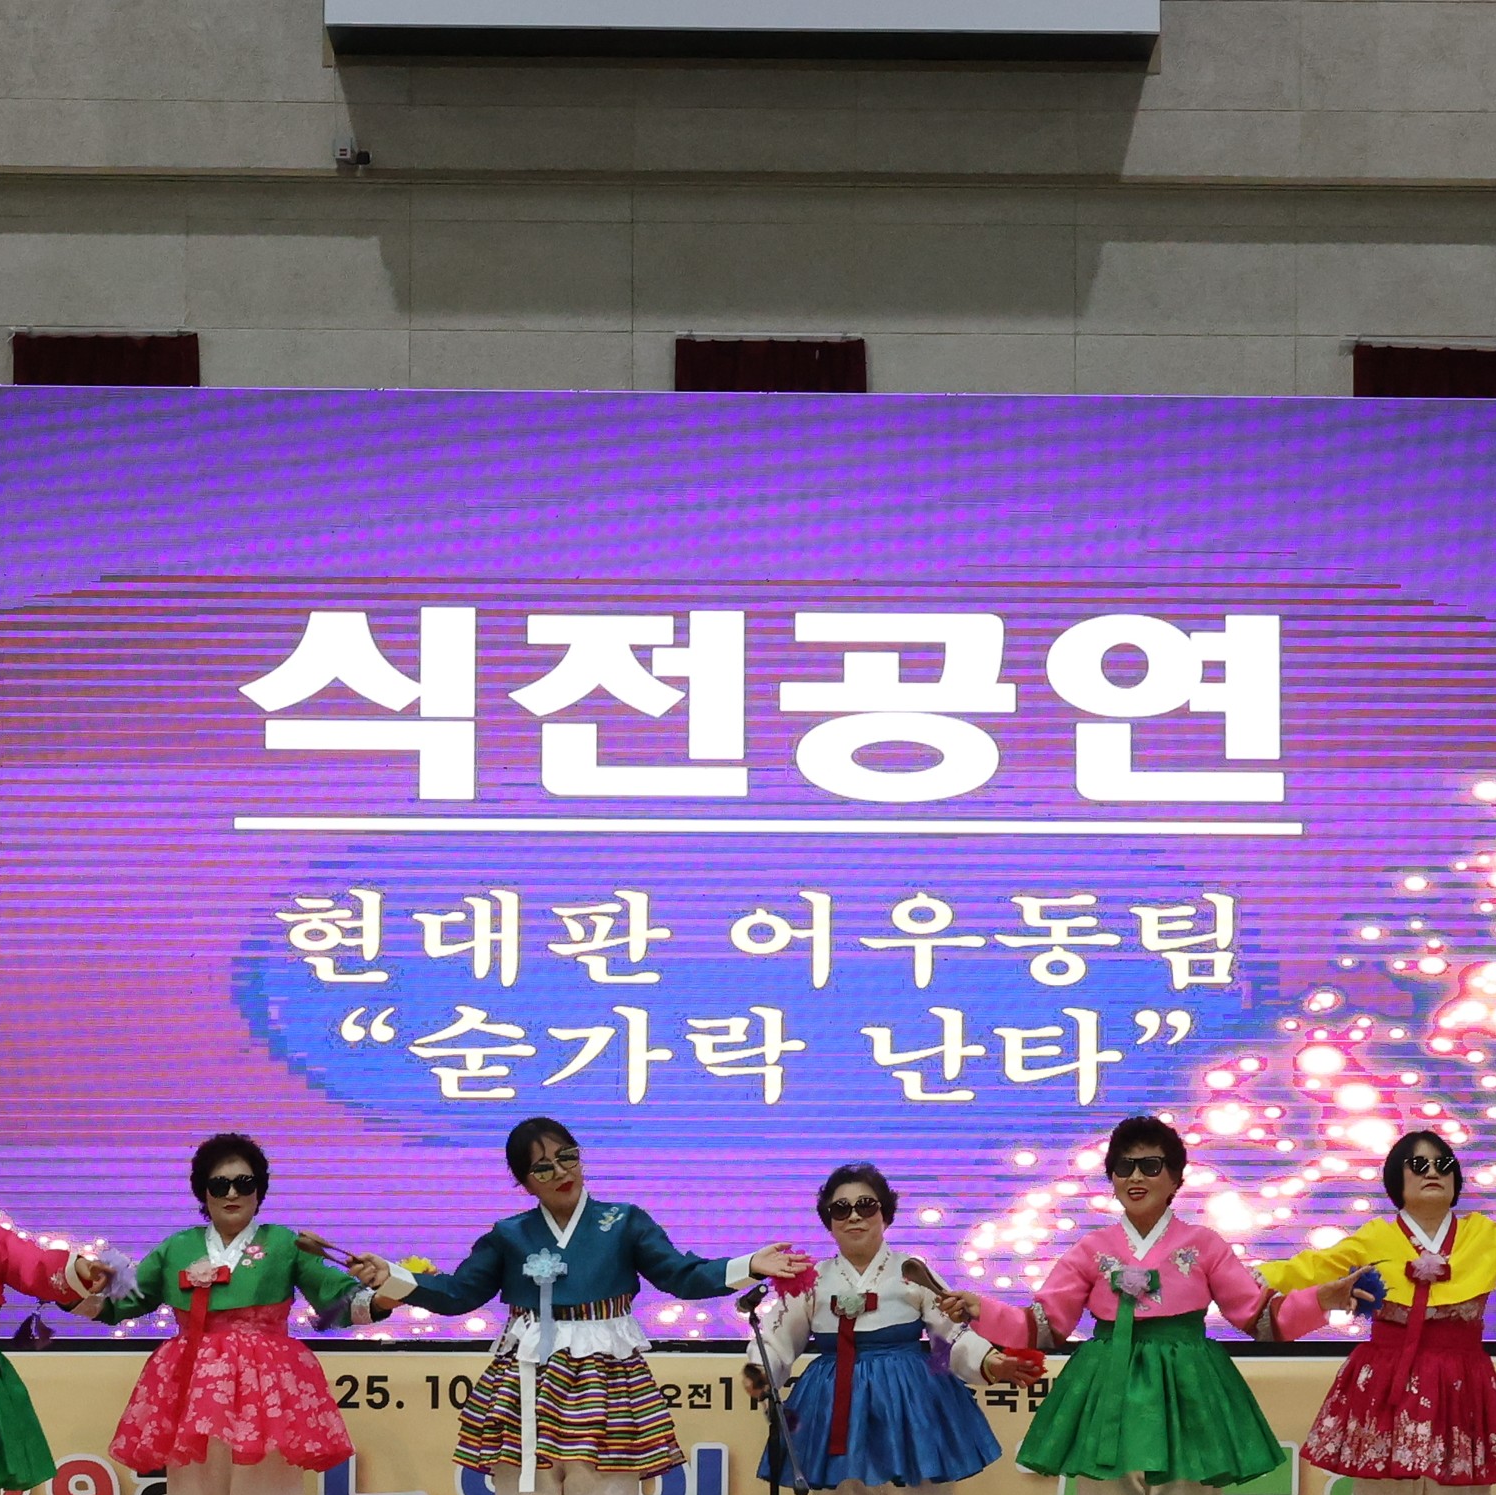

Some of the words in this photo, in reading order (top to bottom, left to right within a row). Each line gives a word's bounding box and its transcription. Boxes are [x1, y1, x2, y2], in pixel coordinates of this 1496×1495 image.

[237, 606, 1285, 803] 식전공연
[275, 886, 673, 985] 현대판
[728, 888, 1241, 991] 어우동팀
[860, 1004, 1194, 1106] 난타”
